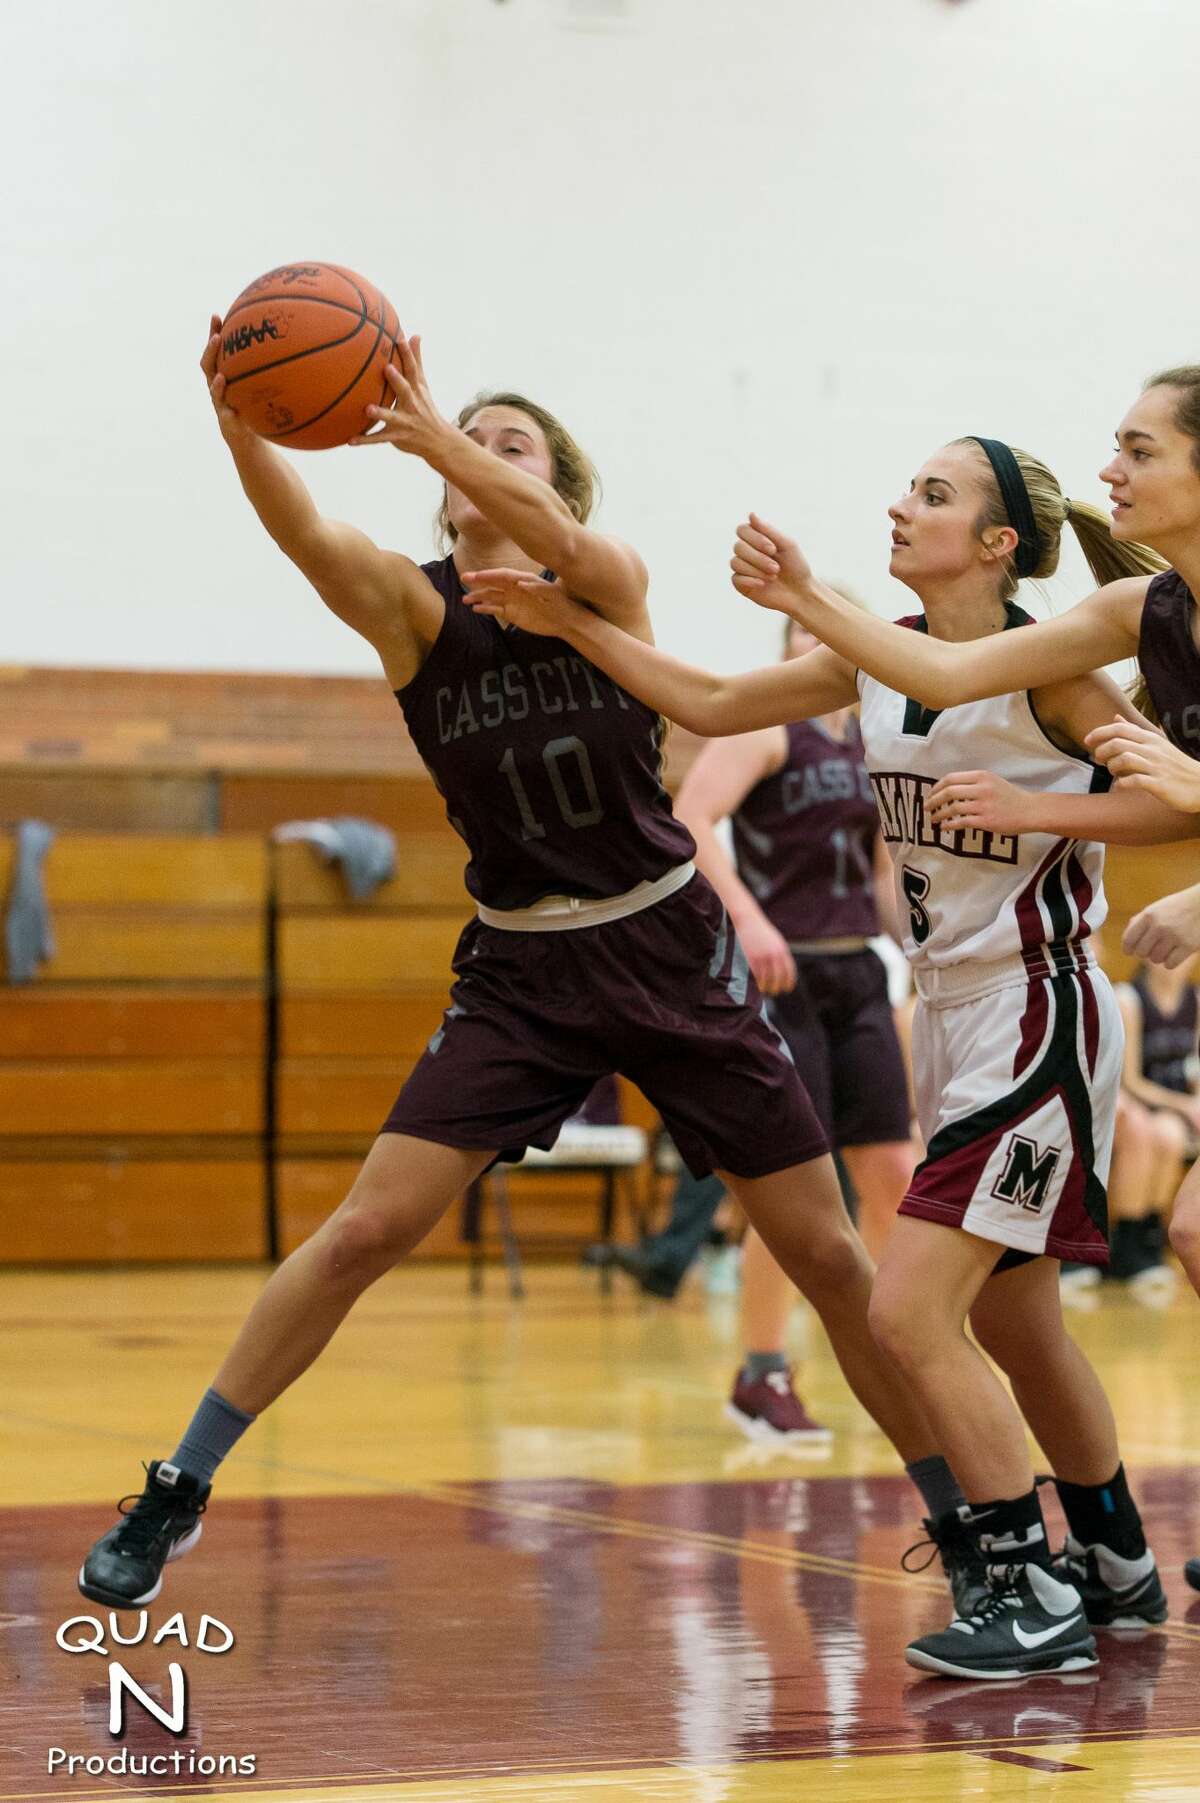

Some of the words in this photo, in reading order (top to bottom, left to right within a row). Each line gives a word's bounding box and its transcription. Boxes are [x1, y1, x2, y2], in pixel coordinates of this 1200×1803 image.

[436, 664, 529, 744] CASS
[530, 657, 629, 714] CIT
[497, 736, 603, 841] 10
[990, 1133, 1061, 1213] M
